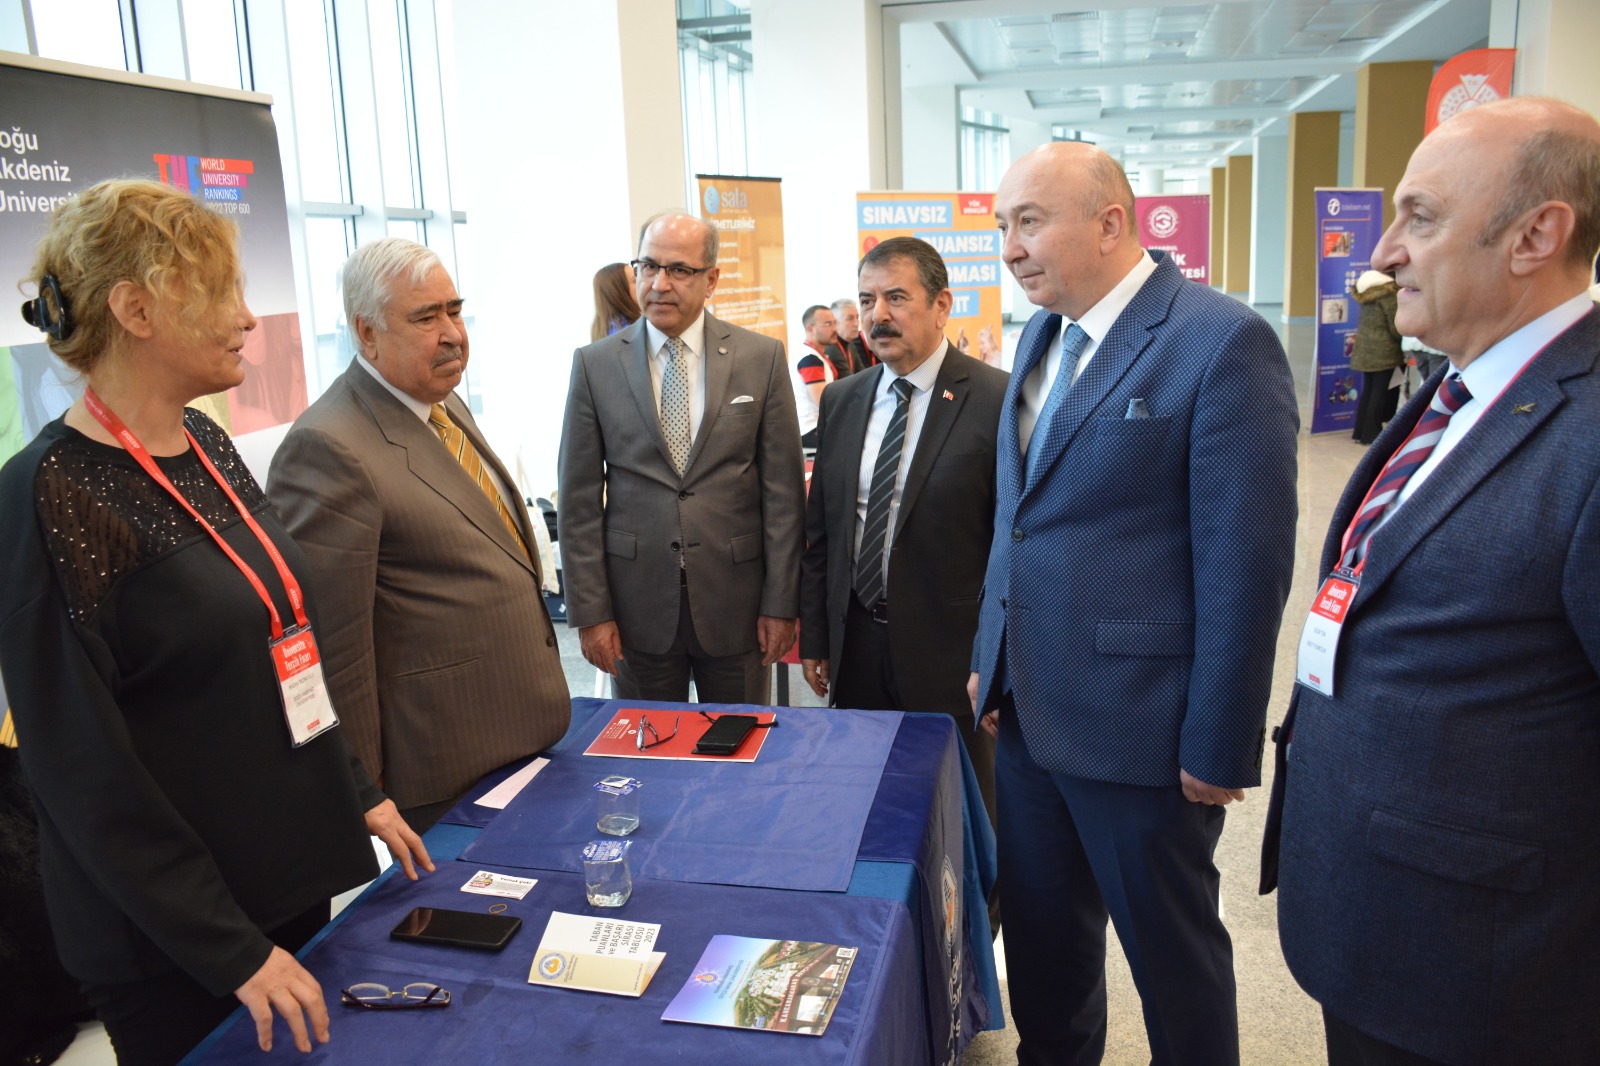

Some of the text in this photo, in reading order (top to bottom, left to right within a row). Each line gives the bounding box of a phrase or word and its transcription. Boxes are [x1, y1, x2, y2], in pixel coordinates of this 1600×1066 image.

[0, 126, 39, 155] oğu
[0, 157, 72, 182] kdeniz
[200, 158, 225, 171] WORLD
[202, 173, 240, 186] UNIVERSITY
[204, 188, 239, 201] RANKINGS
[223, 202, 238, 214] TOP
[238, 203, 251, 215] 600
[863, 206, 947, 225] SINAVSIZ
[947, 264, 996, 283] OMASI
[590, 921, 603, 942] TABAN
[596, 922, 614, 954] PUANLARI
[608, 924, 624, 955] ve BAŞARI
[621, 925, 635, 946] SIRASI
[629, 927, 645, 954] TABLOSU
[644, 928, 656, 943] 2023
